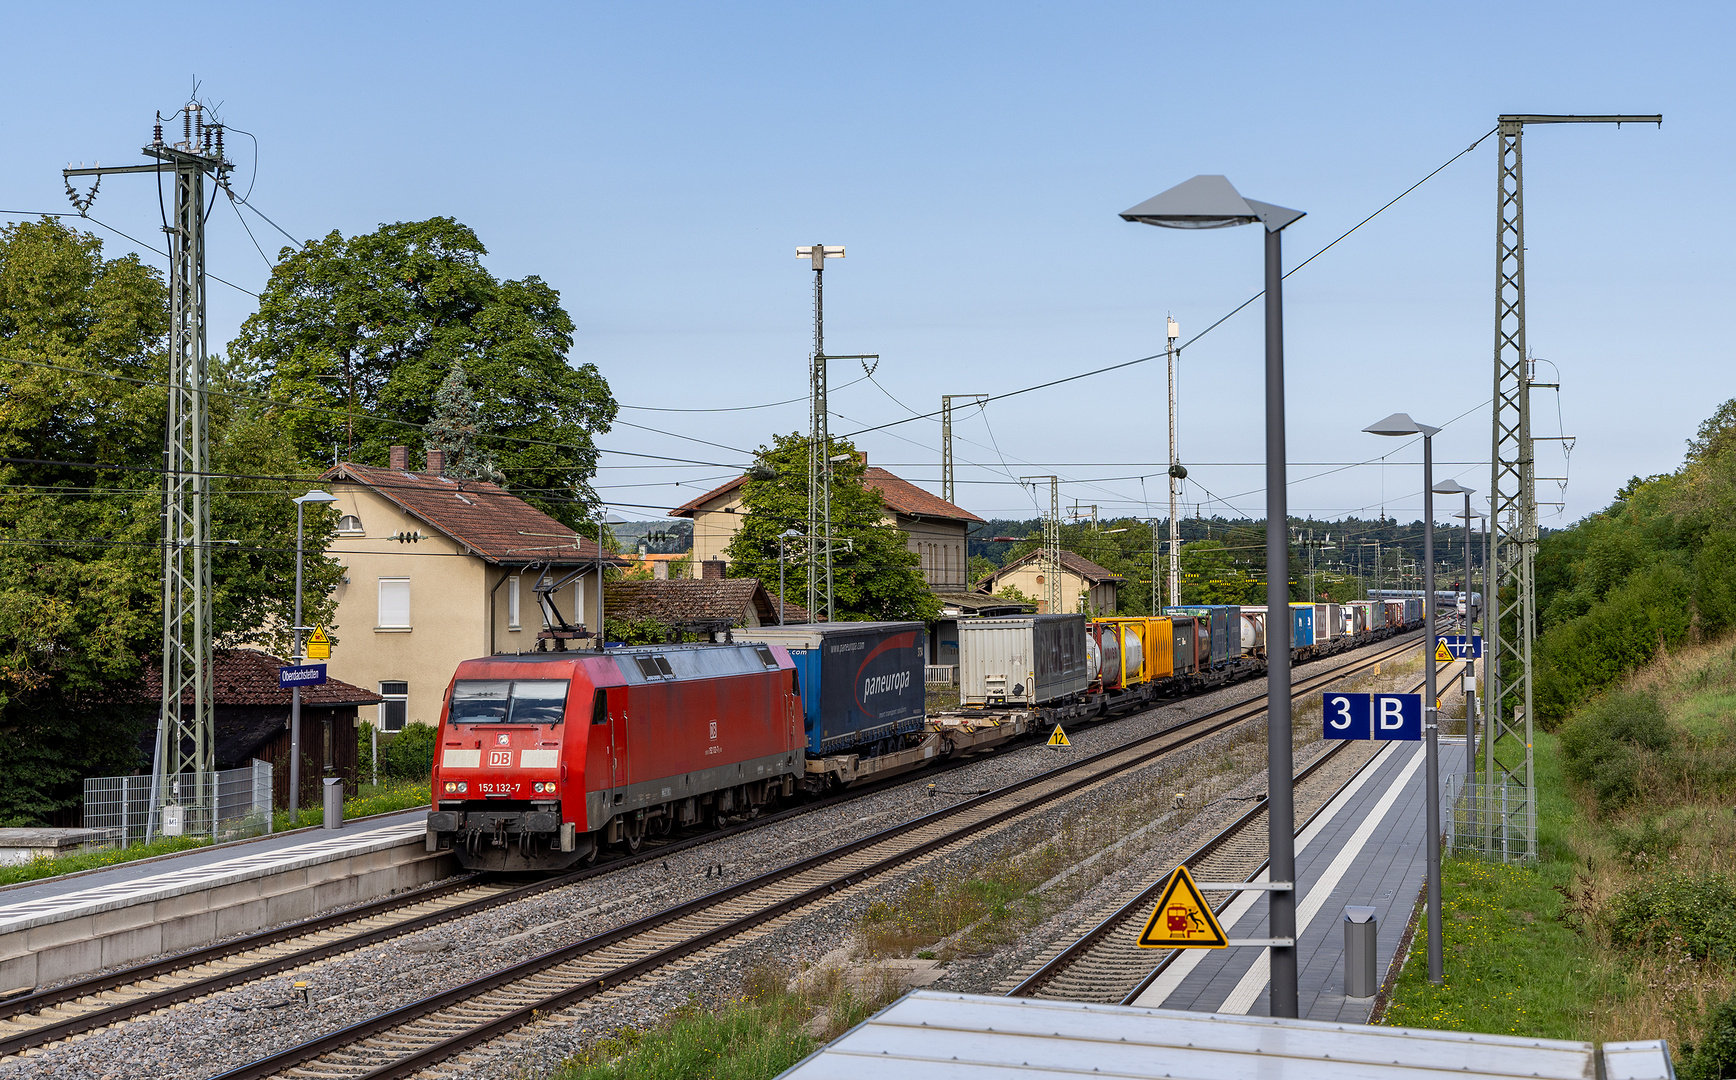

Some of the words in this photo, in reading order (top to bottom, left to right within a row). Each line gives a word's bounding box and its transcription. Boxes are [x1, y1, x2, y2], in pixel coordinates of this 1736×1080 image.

[281, 669, 319, 682] Oberdachstetten
[863, 670, 910, 703] paneuropa
[1330, 697, 1352, 730] 3
[1380, 697, 1404, 730] B
[1054, 732, 1064, 745] 12
[491, 752, 510, 765] DB
[479, 783, 493, 792] 152
[496, 783, 521, 792] 132-7
